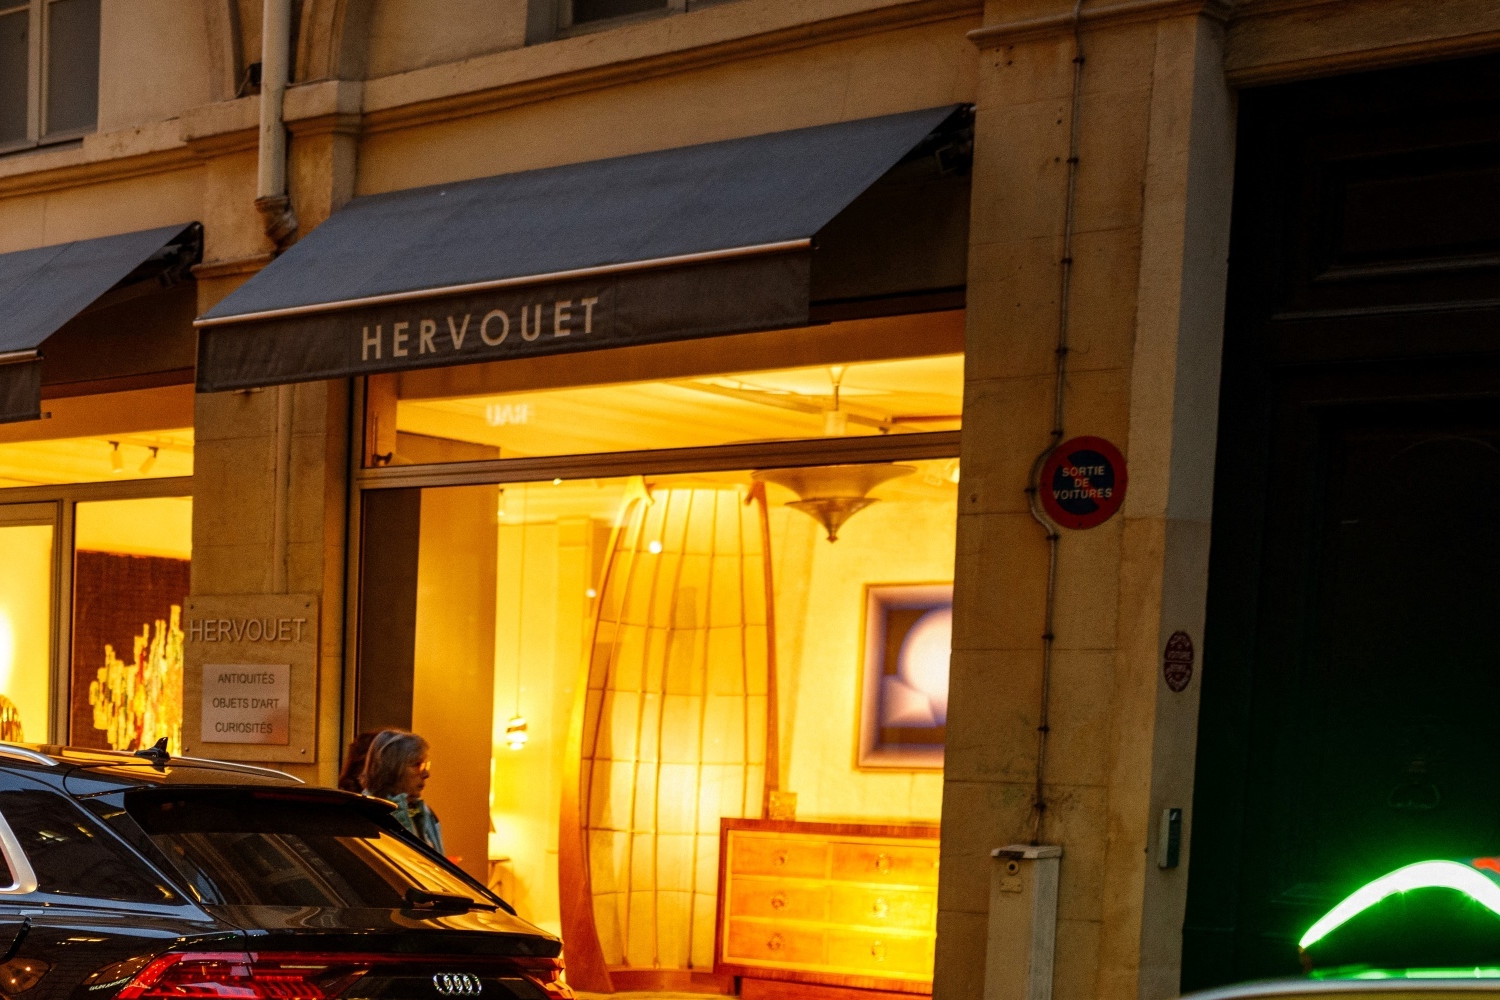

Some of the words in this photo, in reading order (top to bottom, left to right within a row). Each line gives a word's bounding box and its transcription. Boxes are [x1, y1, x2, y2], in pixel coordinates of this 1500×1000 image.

[361, 296, 599, 361] HERVOUET
[1061, 465, 1106, 477] SORTIE
[1073, 477, 1090, 488] DE
[1052, 487, 1113, 500] VOITURES
[188, 617, 307, 643] HERVOUET
[217, 672, 275, 685] ANTIQUITÉS
[212, 697, 249, 709] OBJETS
[251, 698, 280, 710] D'ART
[214, 721, 273, 734] CURIOSITÉS
